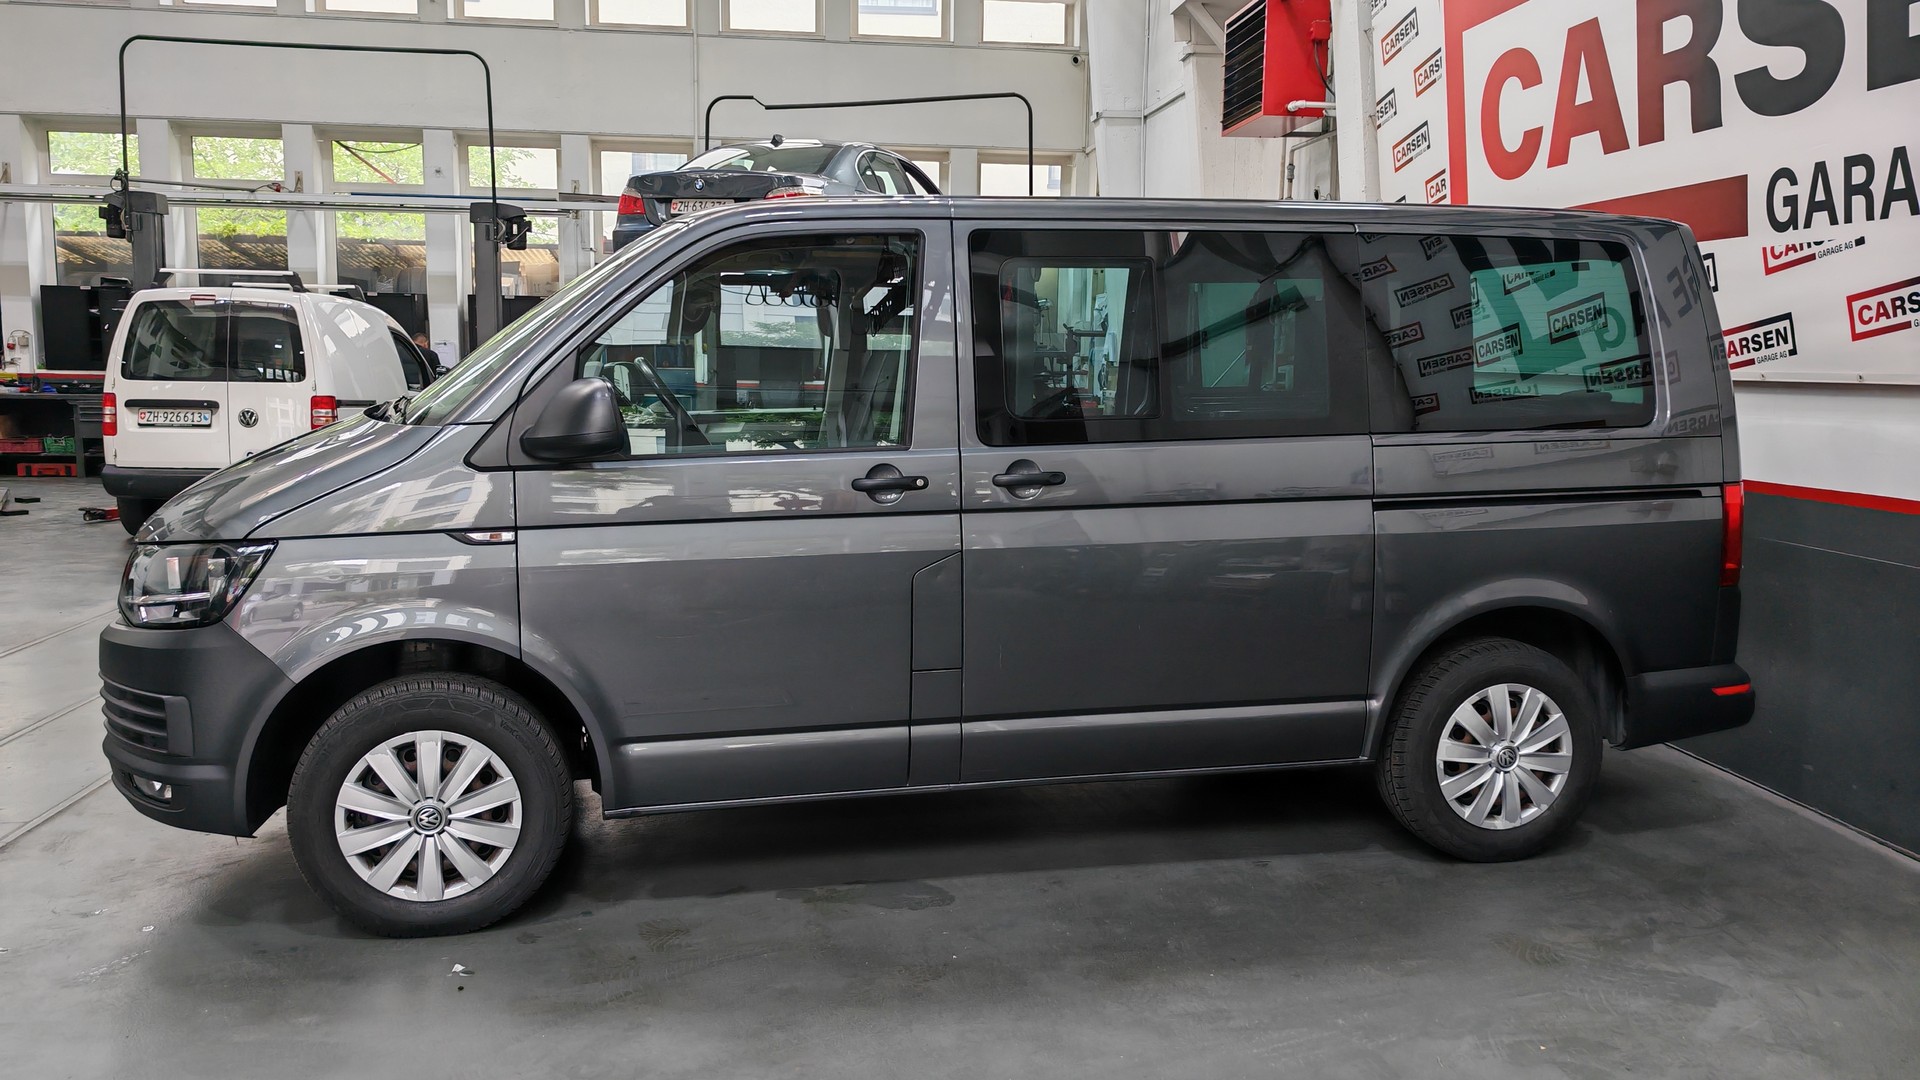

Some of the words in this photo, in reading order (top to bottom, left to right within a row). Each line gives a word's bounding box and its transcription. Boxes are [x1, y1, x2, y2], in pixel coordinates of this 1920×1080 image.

[1384, 17, 1416, 55] CARSEN
[1396, 130, 1428, 163] CARSEN
[1817, 243, 1844, 259] GARAGE
[1844, 240, 1854, 251] AG
[1553, 303, 1602, 334] CARSEN
[1478, 333, 1519, 358] CARSEN
[1756, 352, 1779, 364] GARAGE
[1779, 350, 1788, 359] AG
